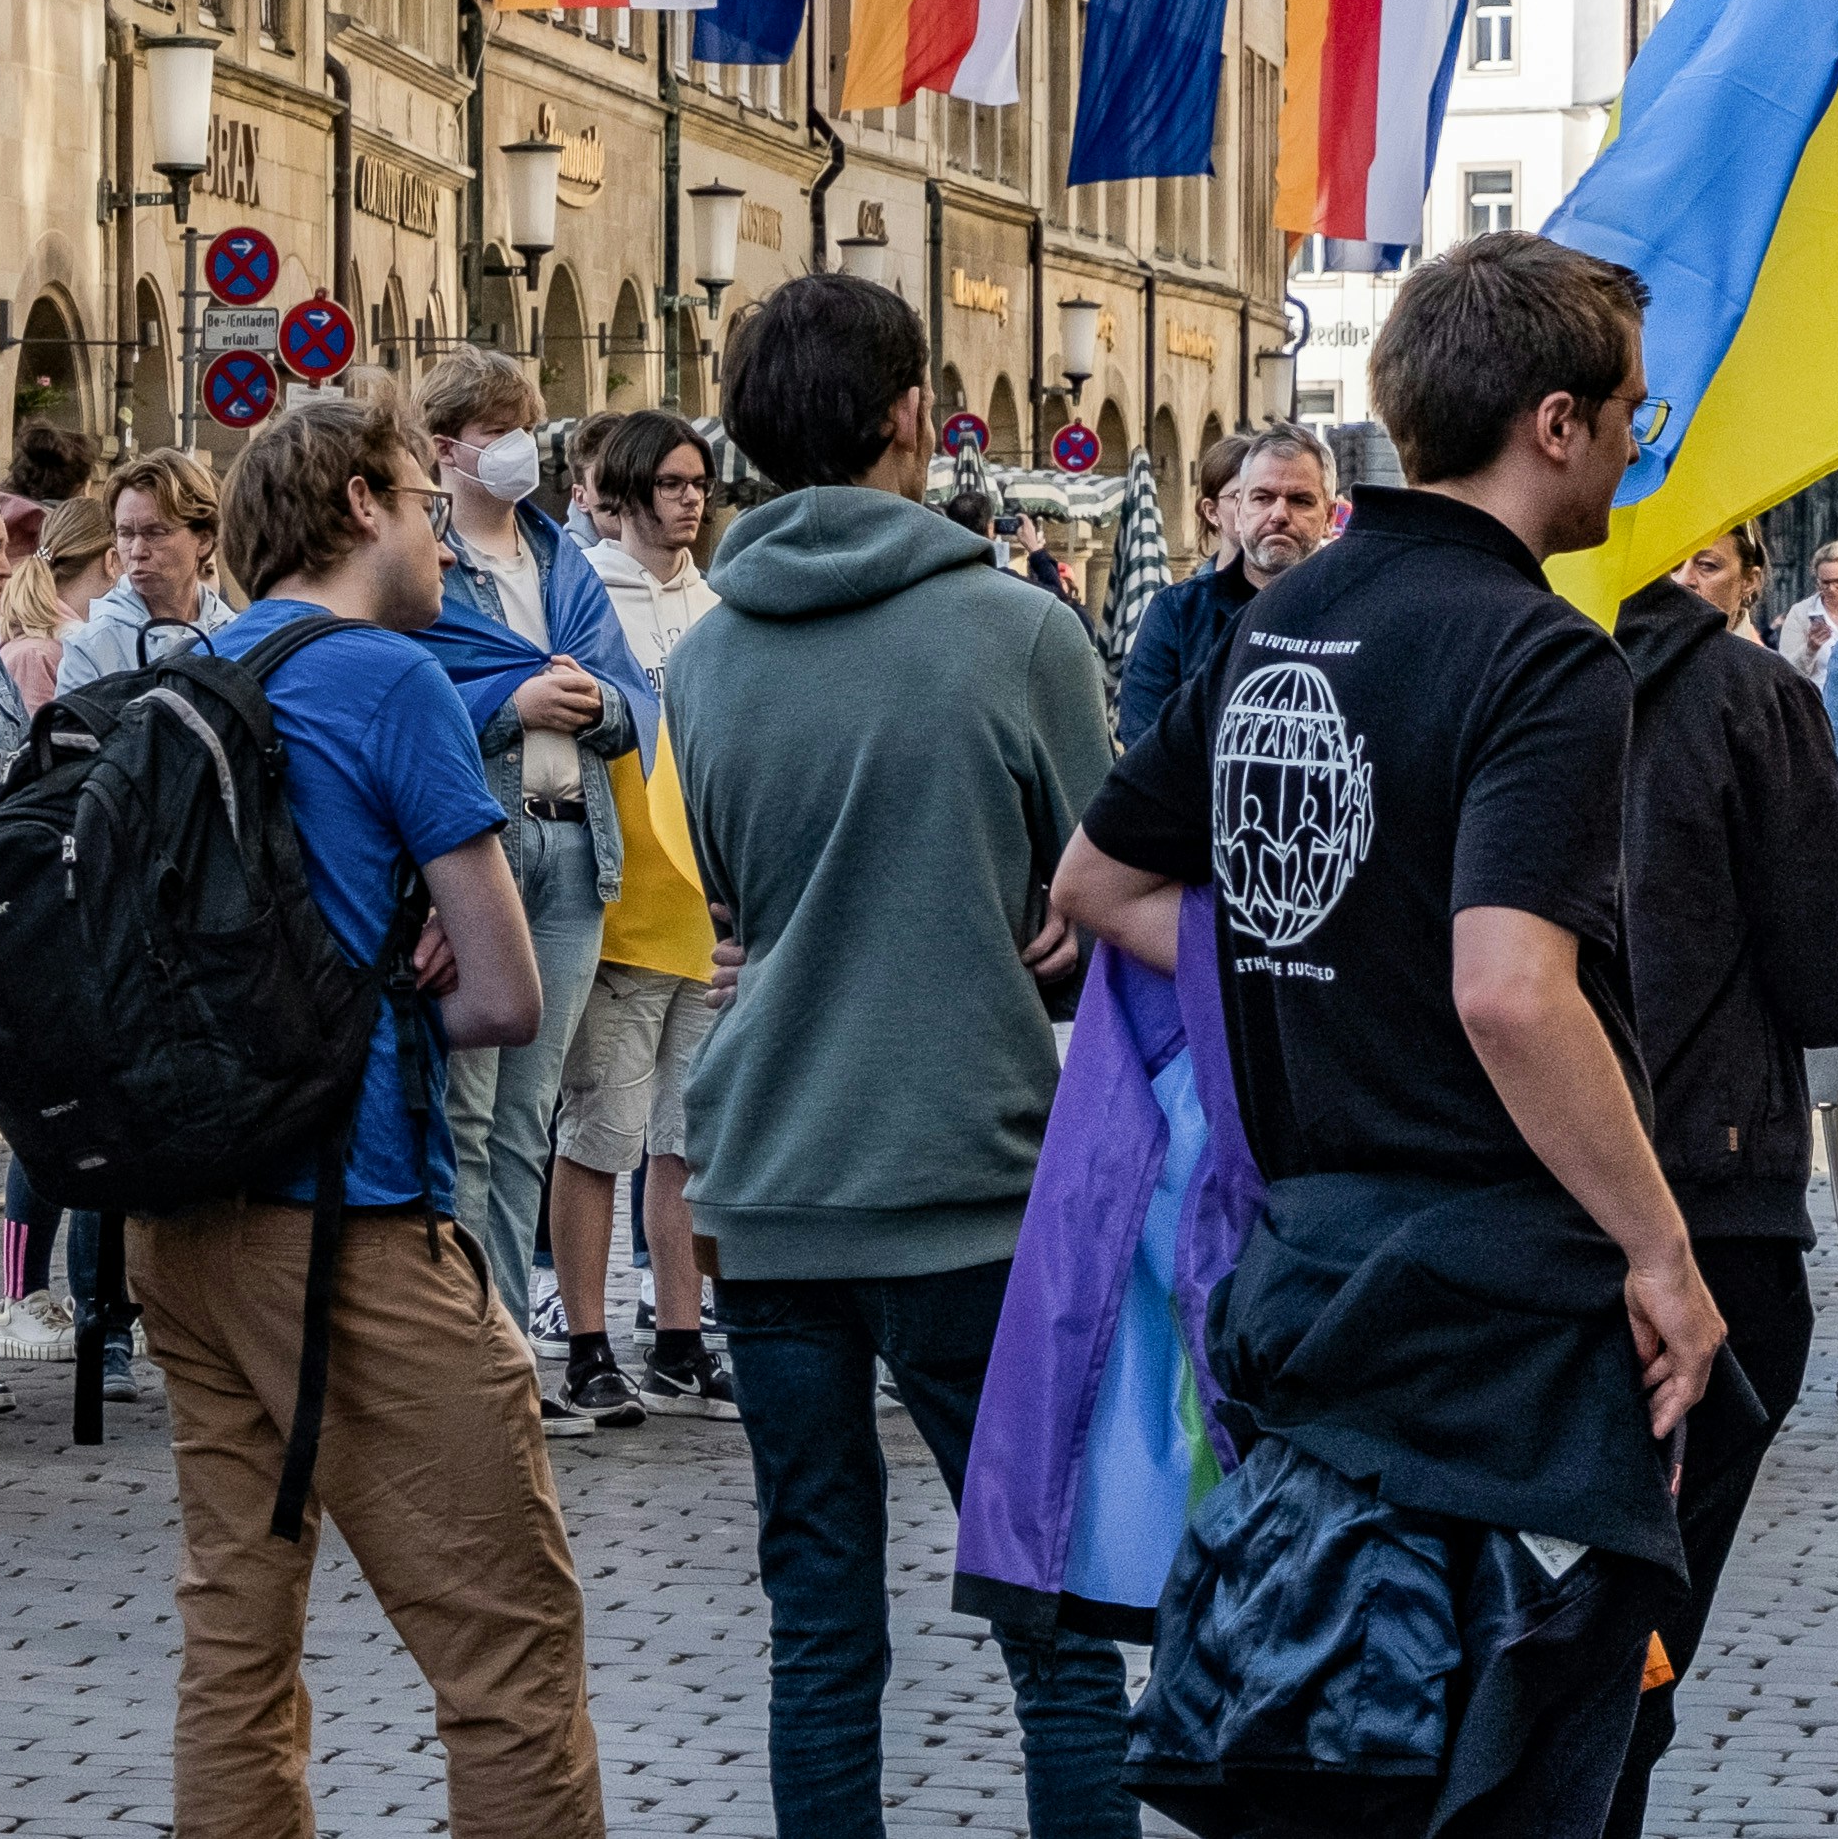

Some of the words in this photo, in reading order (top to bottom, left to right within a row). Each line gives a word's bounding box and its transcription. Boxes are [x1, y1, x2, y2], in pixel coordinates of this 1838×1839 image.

[222, 333, 259, 346] erlaubt
[1248, 631, 1266, 646] THE
[1265, 634, 1309, 654] FUTURE
[1308, 640, 1321, 654] IS
[1321, 640, 1361, 655] BRIGHT
